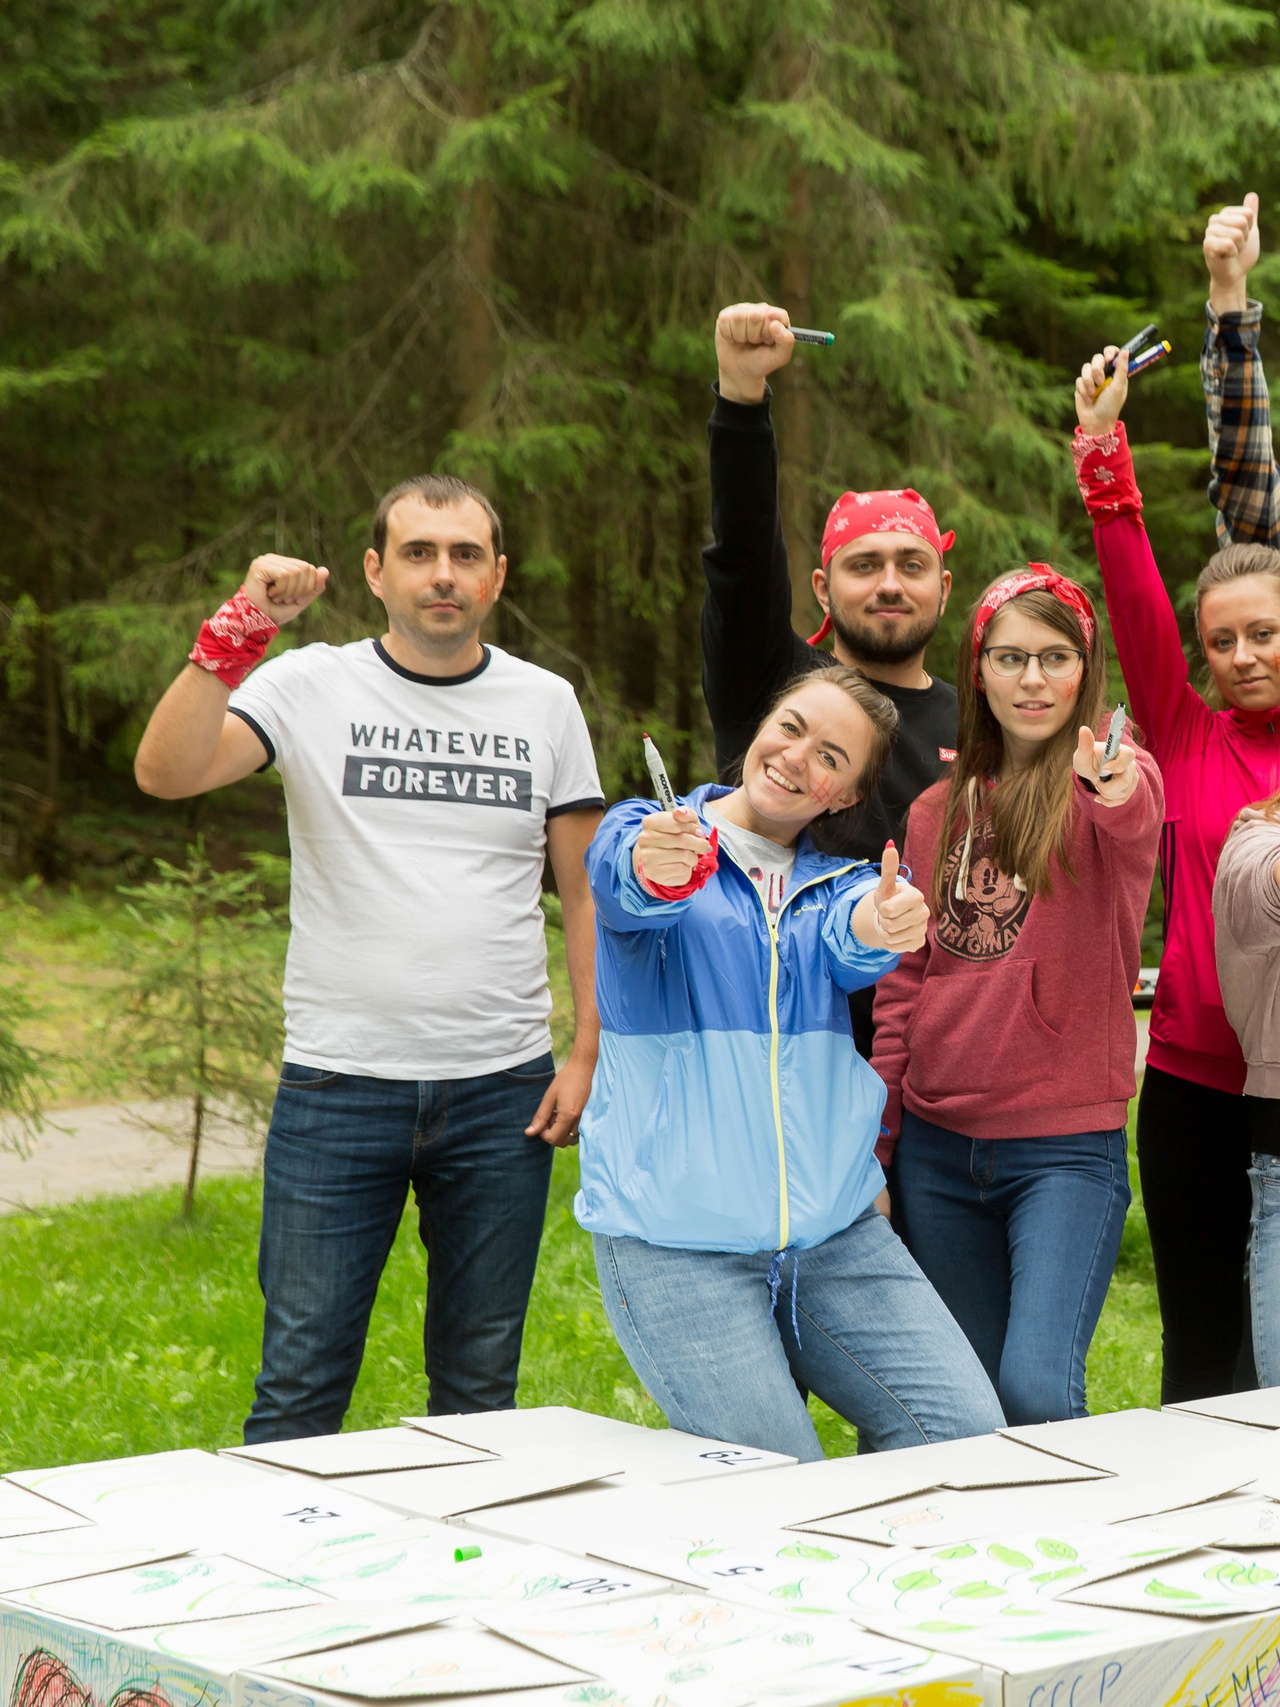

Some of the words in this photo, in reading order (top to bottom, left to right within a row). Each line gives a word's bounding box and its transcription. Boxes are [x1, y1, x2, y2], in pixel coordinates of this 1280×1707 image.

[350, 723, 532, 763] WHATEVER
[940, 749, 957, 761] Sup
[360, 764, 518, 802] FOREVER
[699, 1448, 760, 1466] 79
[283, 1506, 342, 1525] 24
